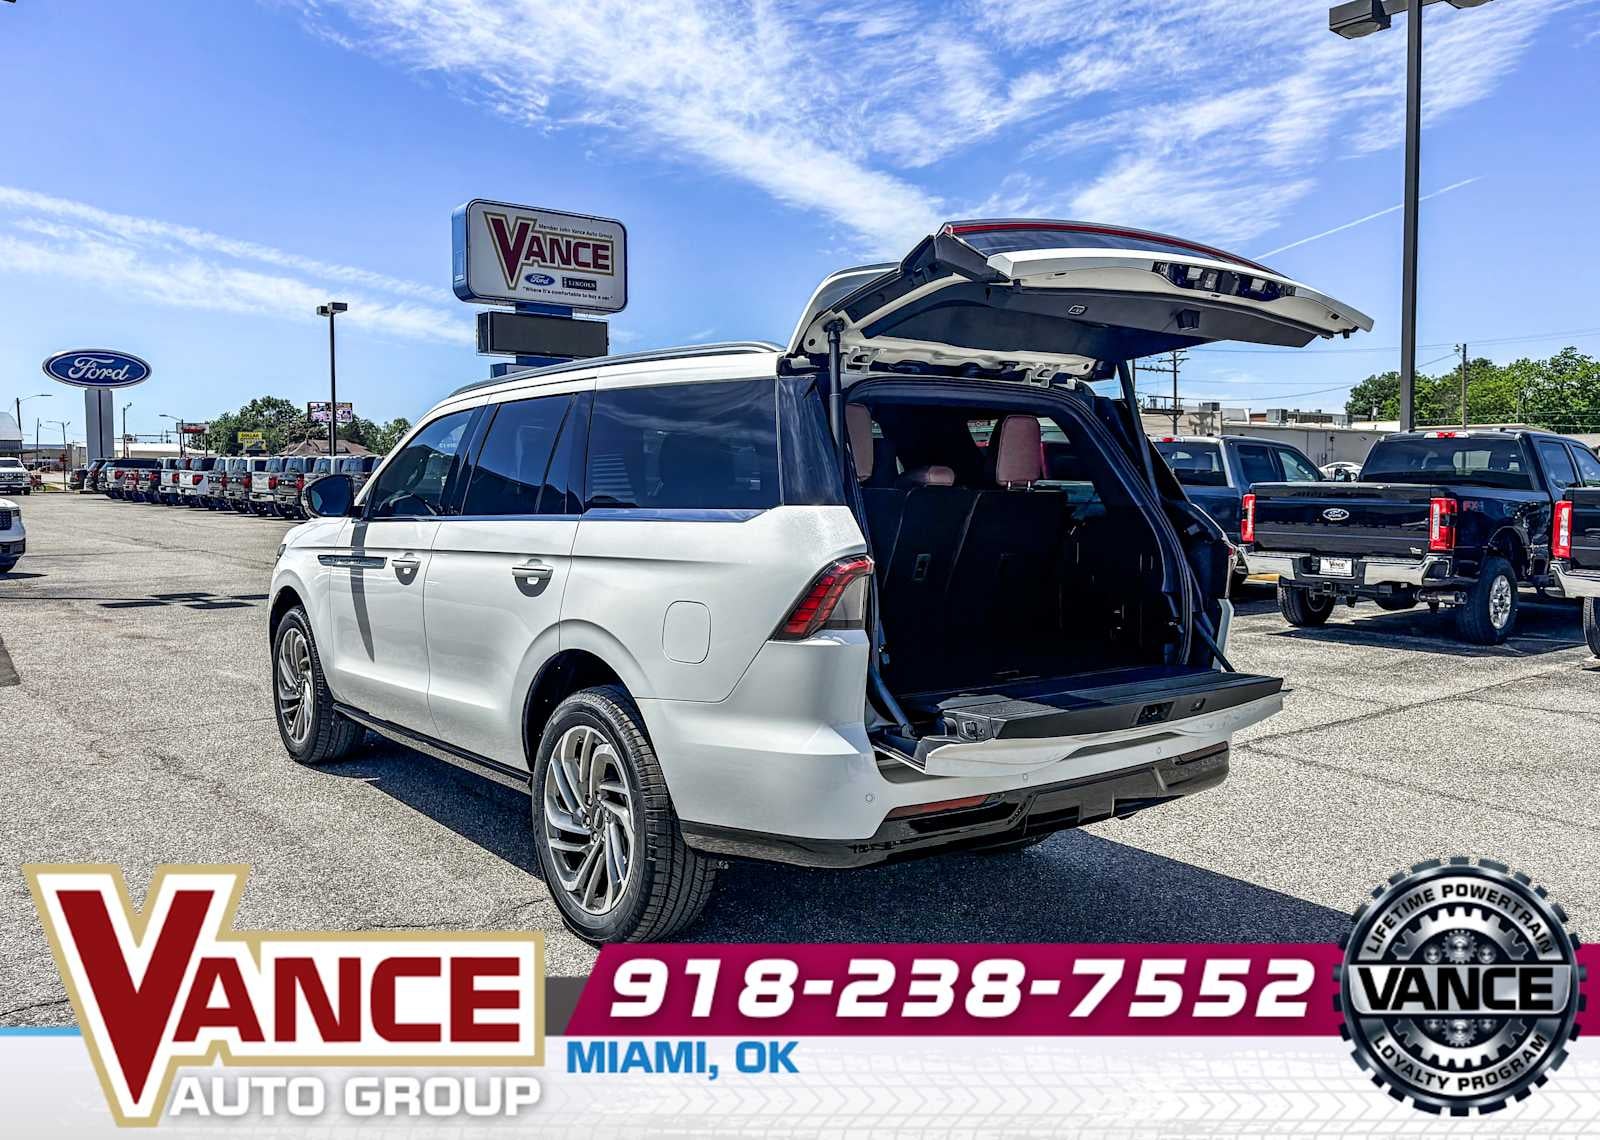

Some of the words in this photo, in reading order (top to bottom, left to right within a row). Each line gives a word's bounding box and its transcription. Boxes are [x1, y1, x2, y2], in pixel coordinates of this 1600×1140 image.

[489, 217, 611, 284] VANCE
[530, 275, 549, 285] Ford
[568, 280, 596, 288] LINCOLN
[67, 356, 131, 381] Ford
